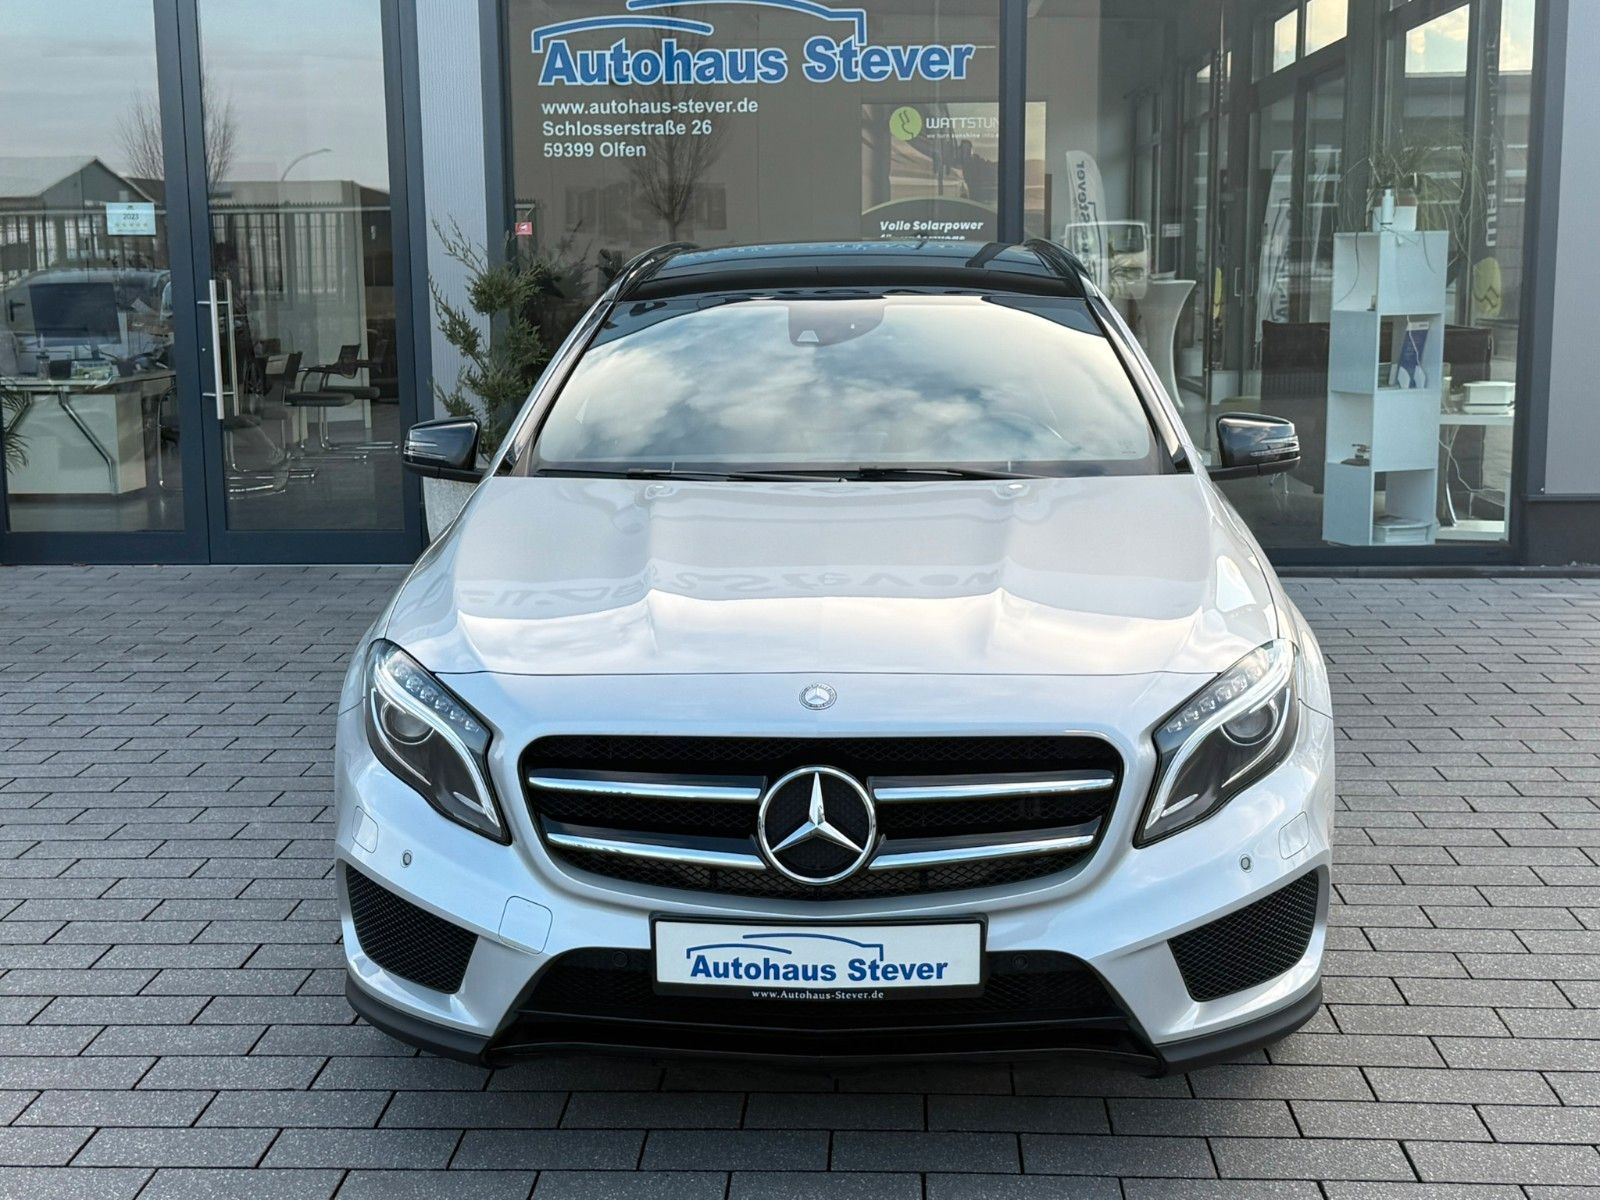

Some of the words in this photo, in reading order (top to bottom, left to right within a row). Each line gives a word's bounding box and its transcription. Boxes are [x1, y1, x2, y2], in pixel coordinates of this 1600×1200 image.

[538, 38, 789, 86] Autohaus
[802, 35, 976, 83] Stever
[541, 97, 759, 114] www.autohaus-stever.de
[542, 119, 686, 136] Schlosserstraße
[691, 119, 712, 135] 26
[543, 142, 594, 158] 59399
[599, 141, 647, 157] Olfen
[880, 220, 911, 231] Volle
[913, 220, 984, 233] Solarpower
[690, 954, 837, 981] Autohaus
[847, 957, 948, 982] Stever
[752, 990, 884, 1000] www.Autohaus-Stever.de
